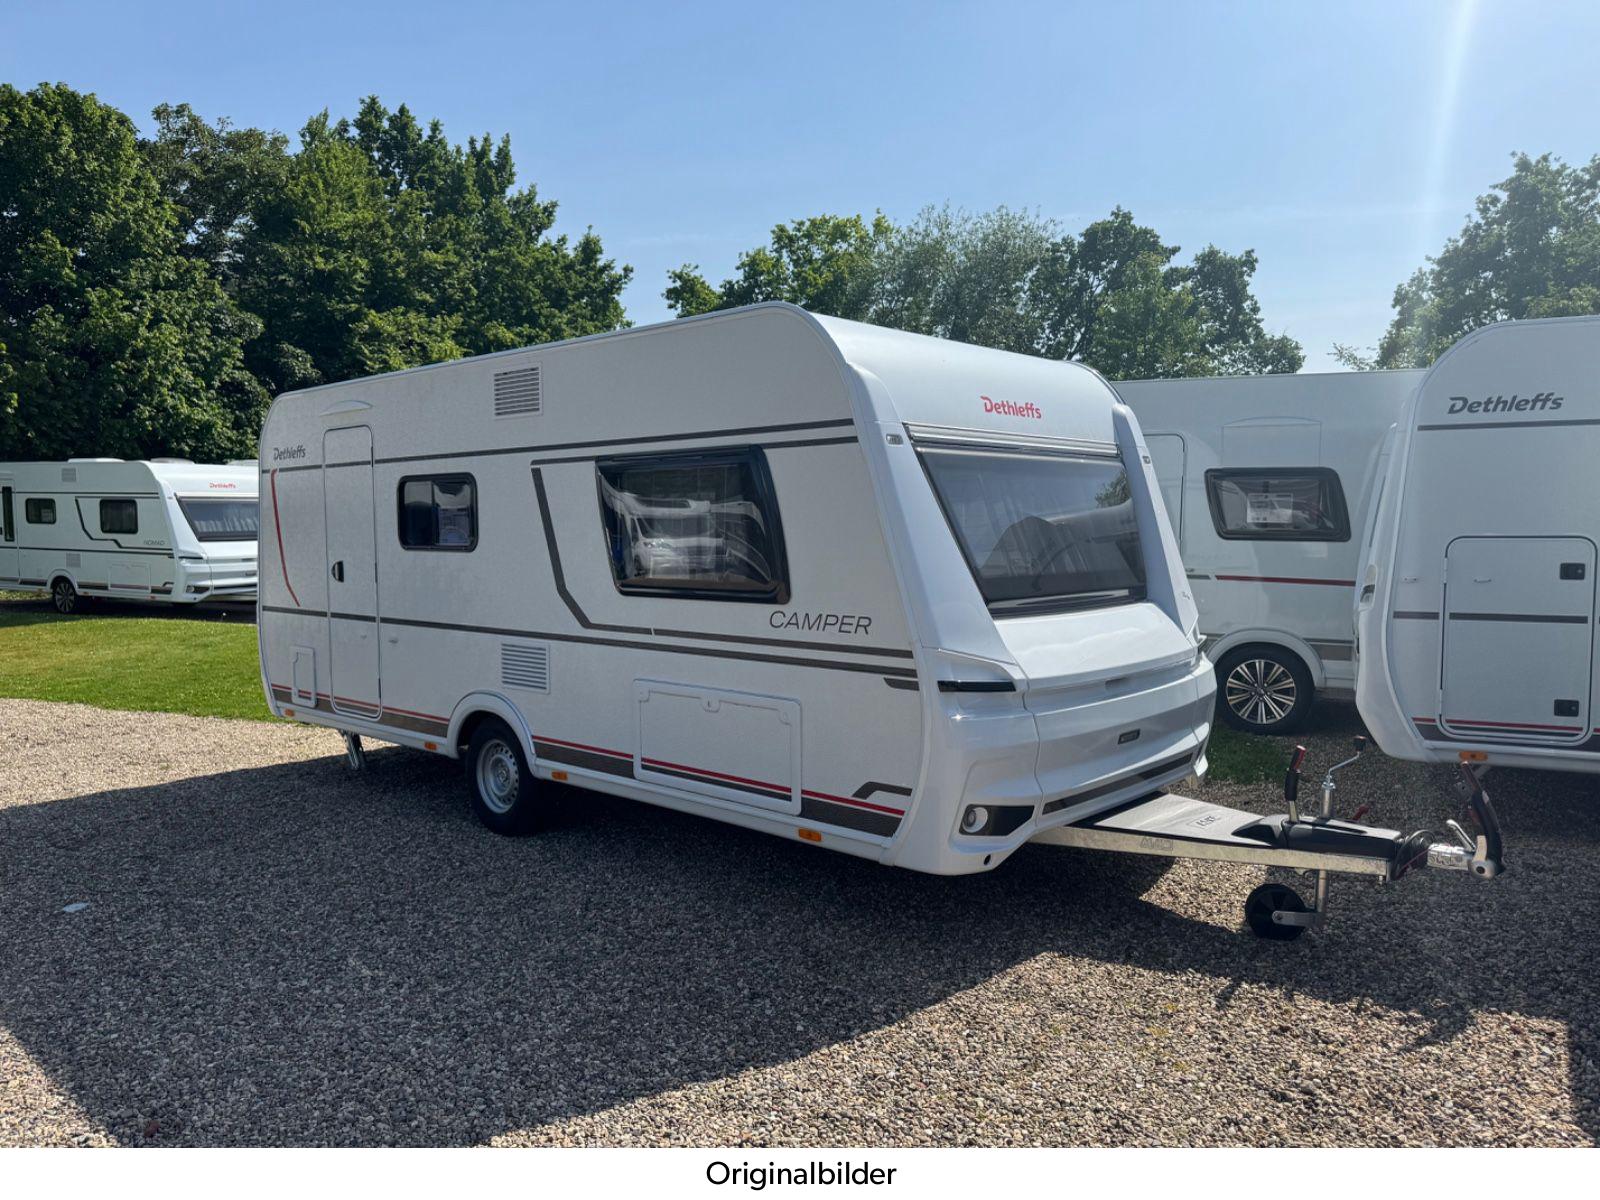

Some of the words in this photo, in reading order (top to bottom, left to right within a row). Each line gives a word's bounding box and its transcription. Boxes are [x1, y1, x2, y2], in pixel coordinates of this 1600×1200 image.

[980, 395, 1042, 419] Dethleffs
[1448, 391, 1564, 415] Dethleffs
[273, 444, 306, 461] Dethleffs
[769, 610, 872, 635] CAMPER
